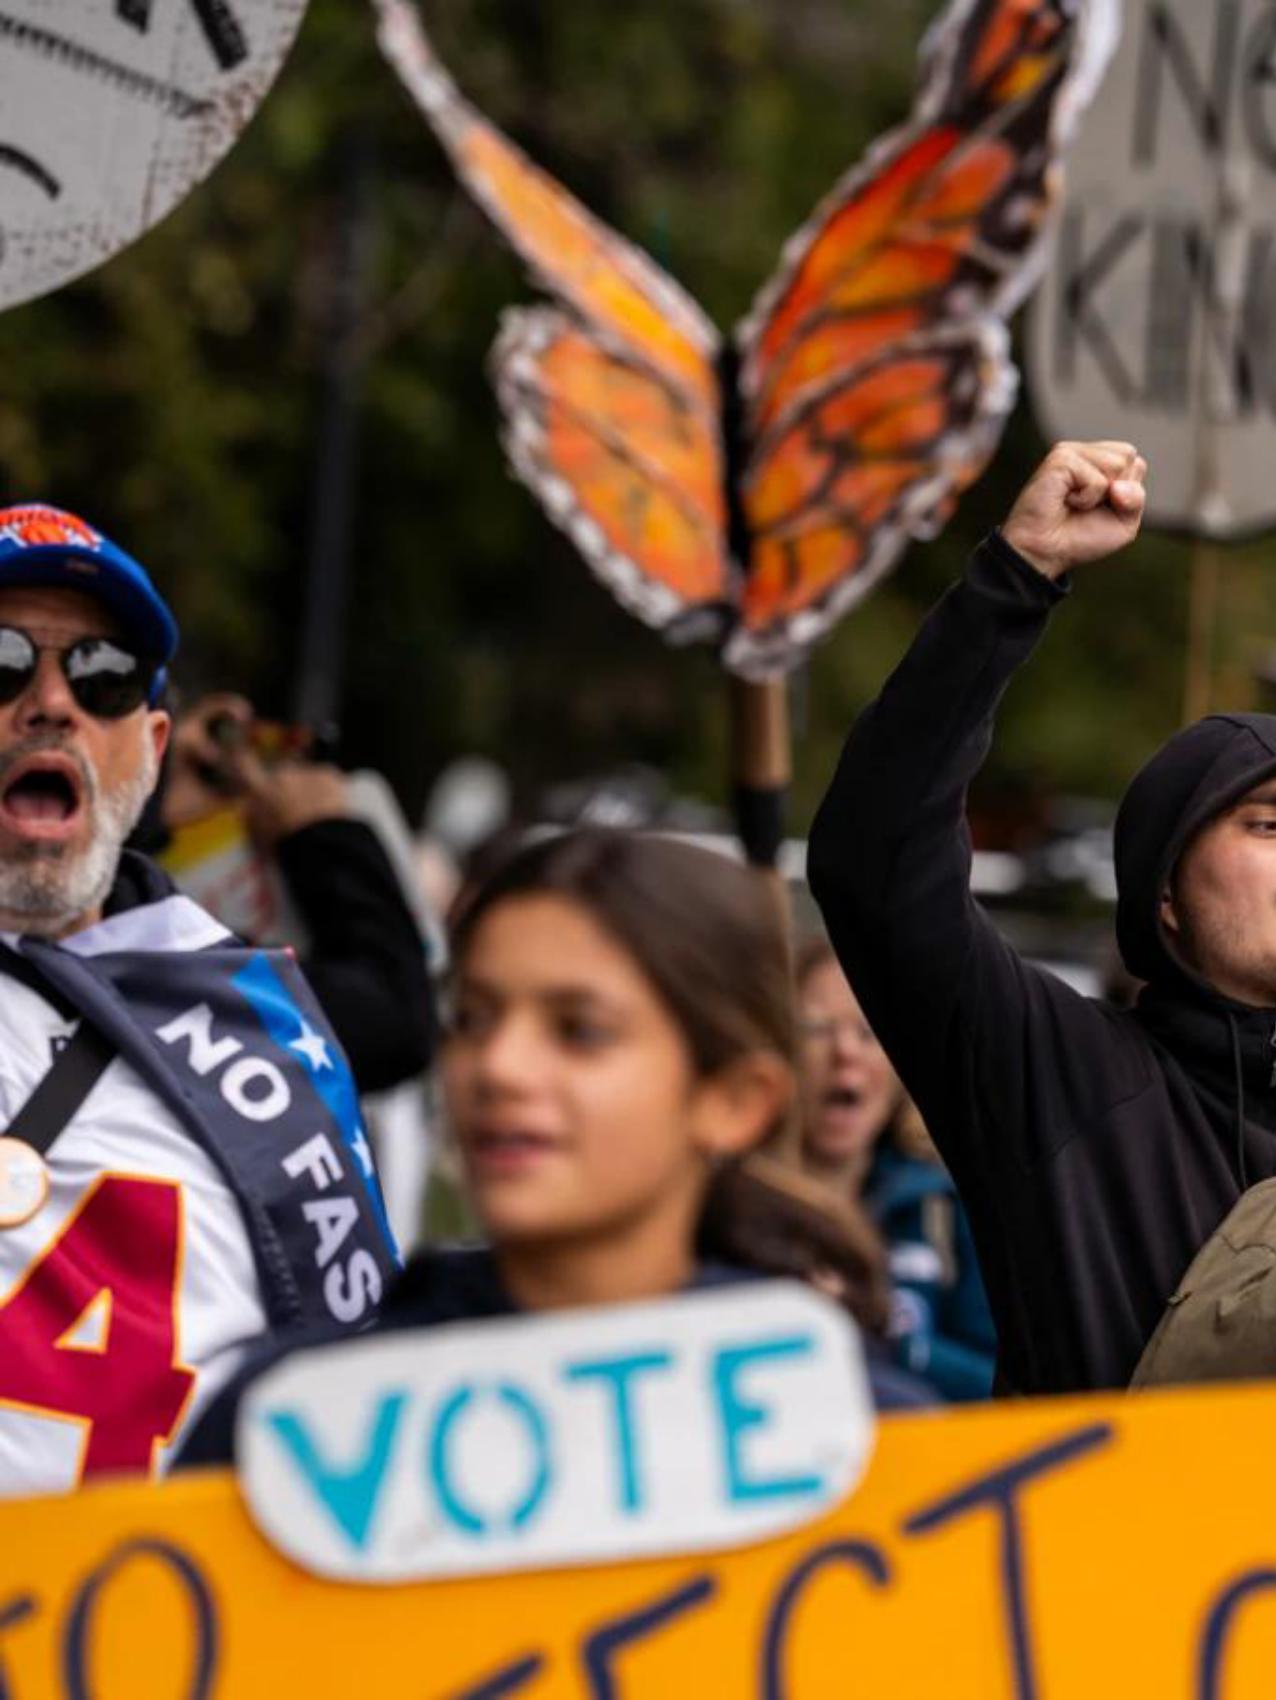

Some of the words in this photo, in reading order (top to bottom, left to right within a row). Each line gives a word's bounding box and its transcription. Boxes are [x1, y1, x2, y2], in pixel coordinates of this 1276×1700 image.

[156, 1002, 291, 1122] NO
[281, 1132, 383, 1328] FAS
[262, 1332, 829, 1554] VOTE
